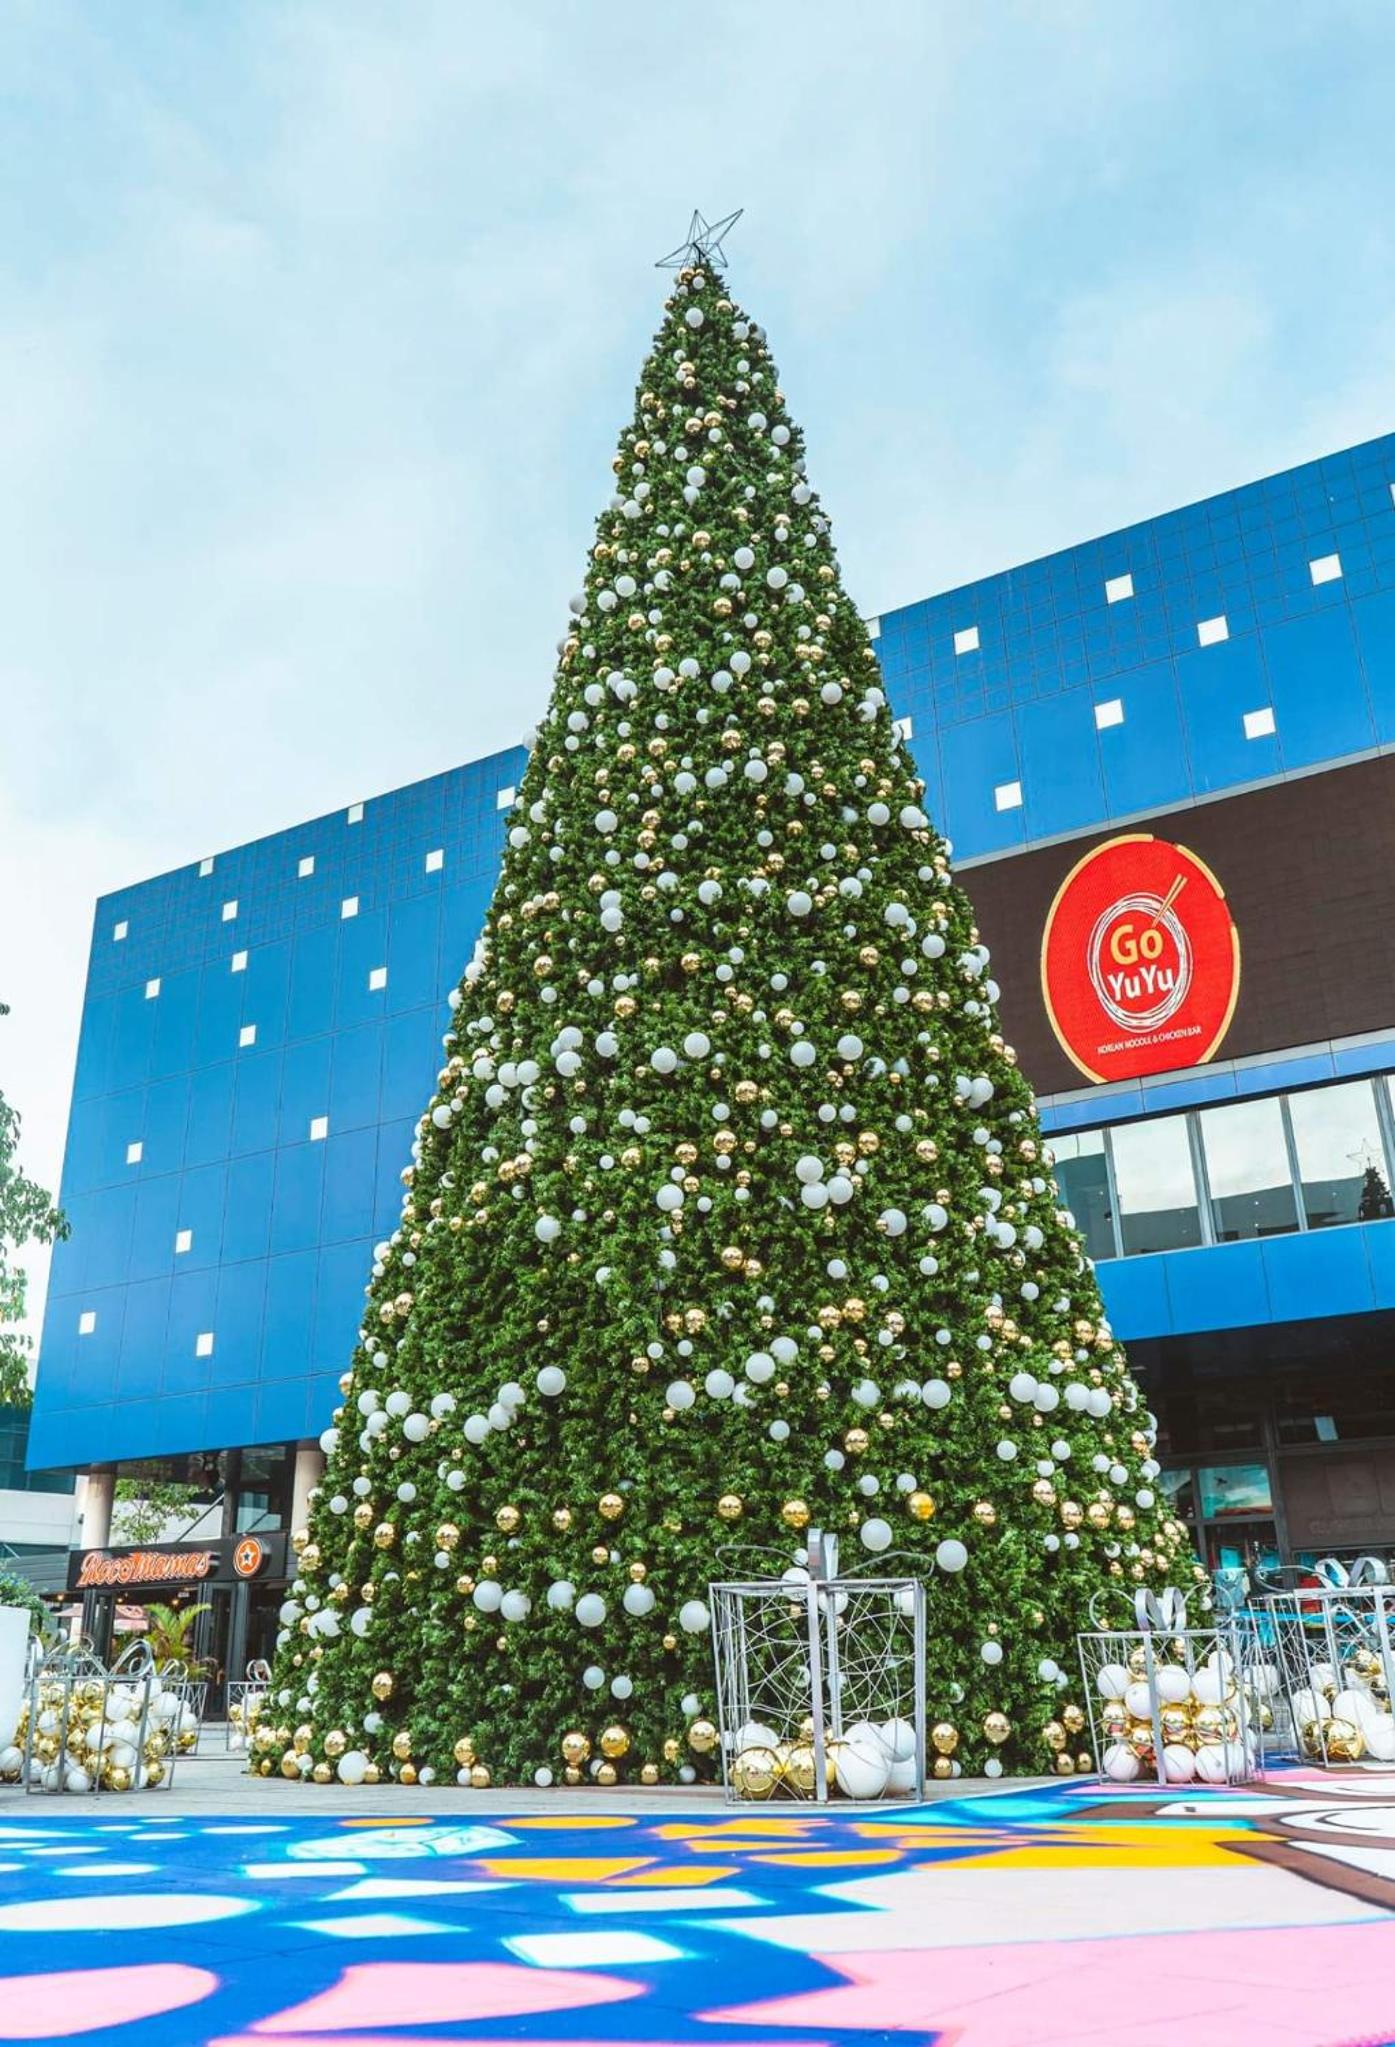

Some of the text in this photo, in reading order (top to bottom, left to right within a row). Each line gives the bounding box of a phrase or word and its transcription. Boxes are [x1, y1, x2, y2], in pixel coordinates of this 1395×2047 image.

[1110, 924, 1163, 965] Go
[1107, 964, 1174, 1001] YuYu
[1097, 1043, 1124, 1054] KOREAN
[1125, 1037, 1152, 1048] NOODLE
[1159, 1029, 1187, 1042] CHICKEN
[1187, 1025, 1201, 1036] BAR
